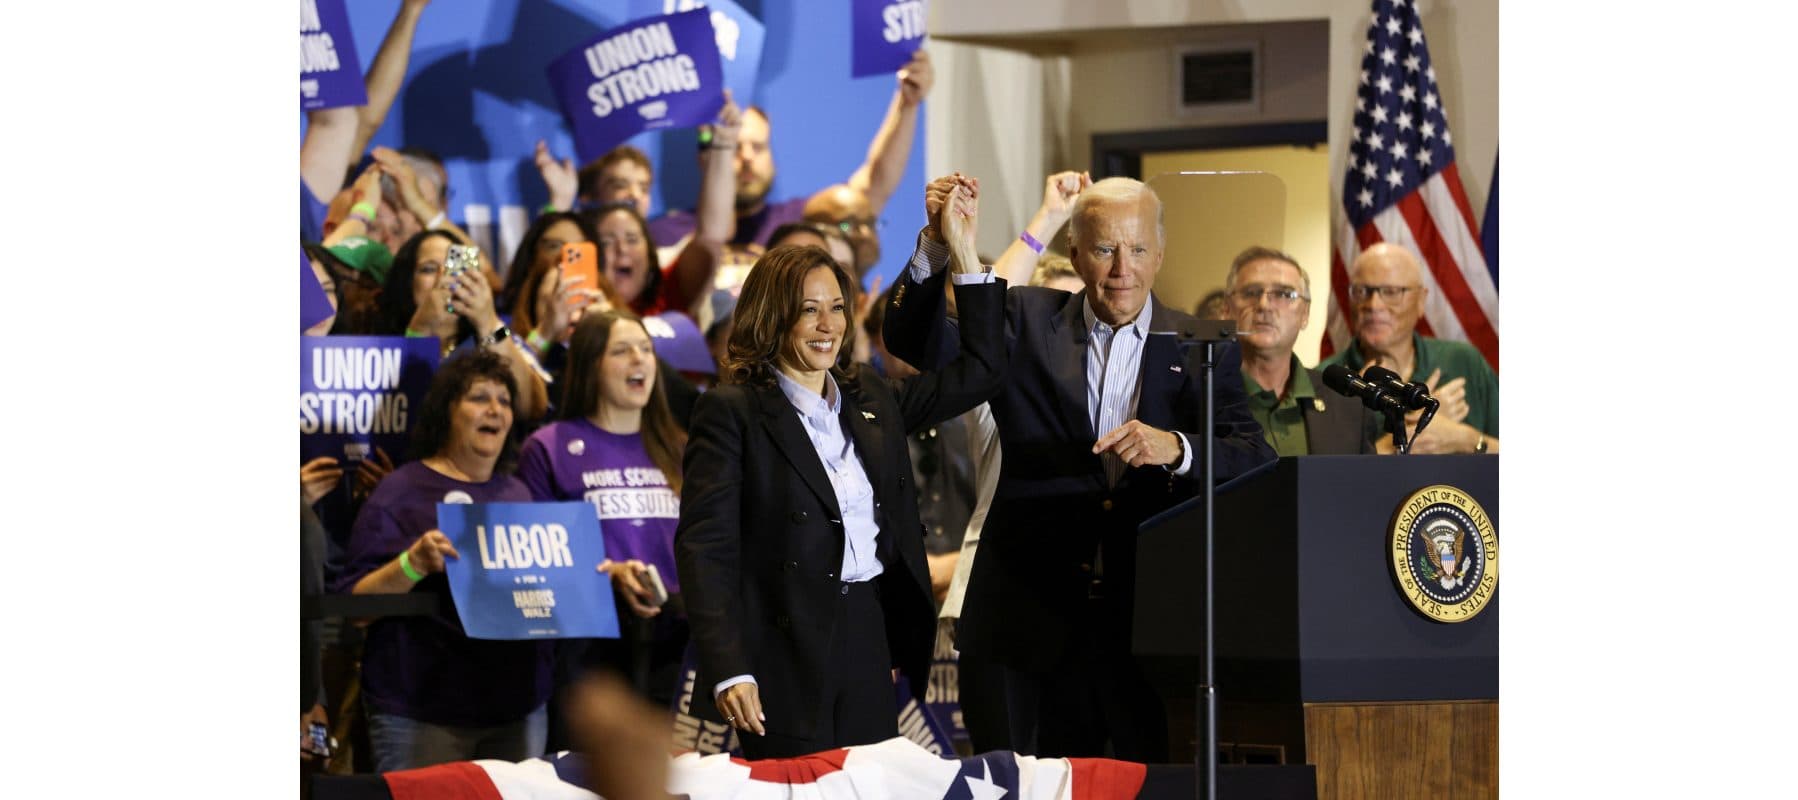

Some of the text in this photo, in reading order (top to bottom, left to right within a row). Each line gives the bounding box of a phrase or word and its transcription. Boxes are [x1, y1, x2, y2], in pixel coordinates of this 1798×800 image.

[584, 22, 677, 78] UNION
[587, 54, 700, 117] STRONG
[313, 347, 402, 390] UNION
[300, 392, 408, 434] STRONG
[582, 467, 668, 488] MORE SCRU
[1441, 491, 1451, 500] OF
[1396, 490, 1438, 551] PRESIDENT
[1453, 494, 1466, 508] THE
[477, 523, 574, 569] LABOR
[1469, 506, 1496, 561] UNITED
[1399, 556, 1408, 576] THE
[512, 589, 556, 608] HARRIS
[522, 607, 552, 618] WALZ
[1414, 588, 1442, 616] SEAL
[1460, 573, 1494, 616] STATES
